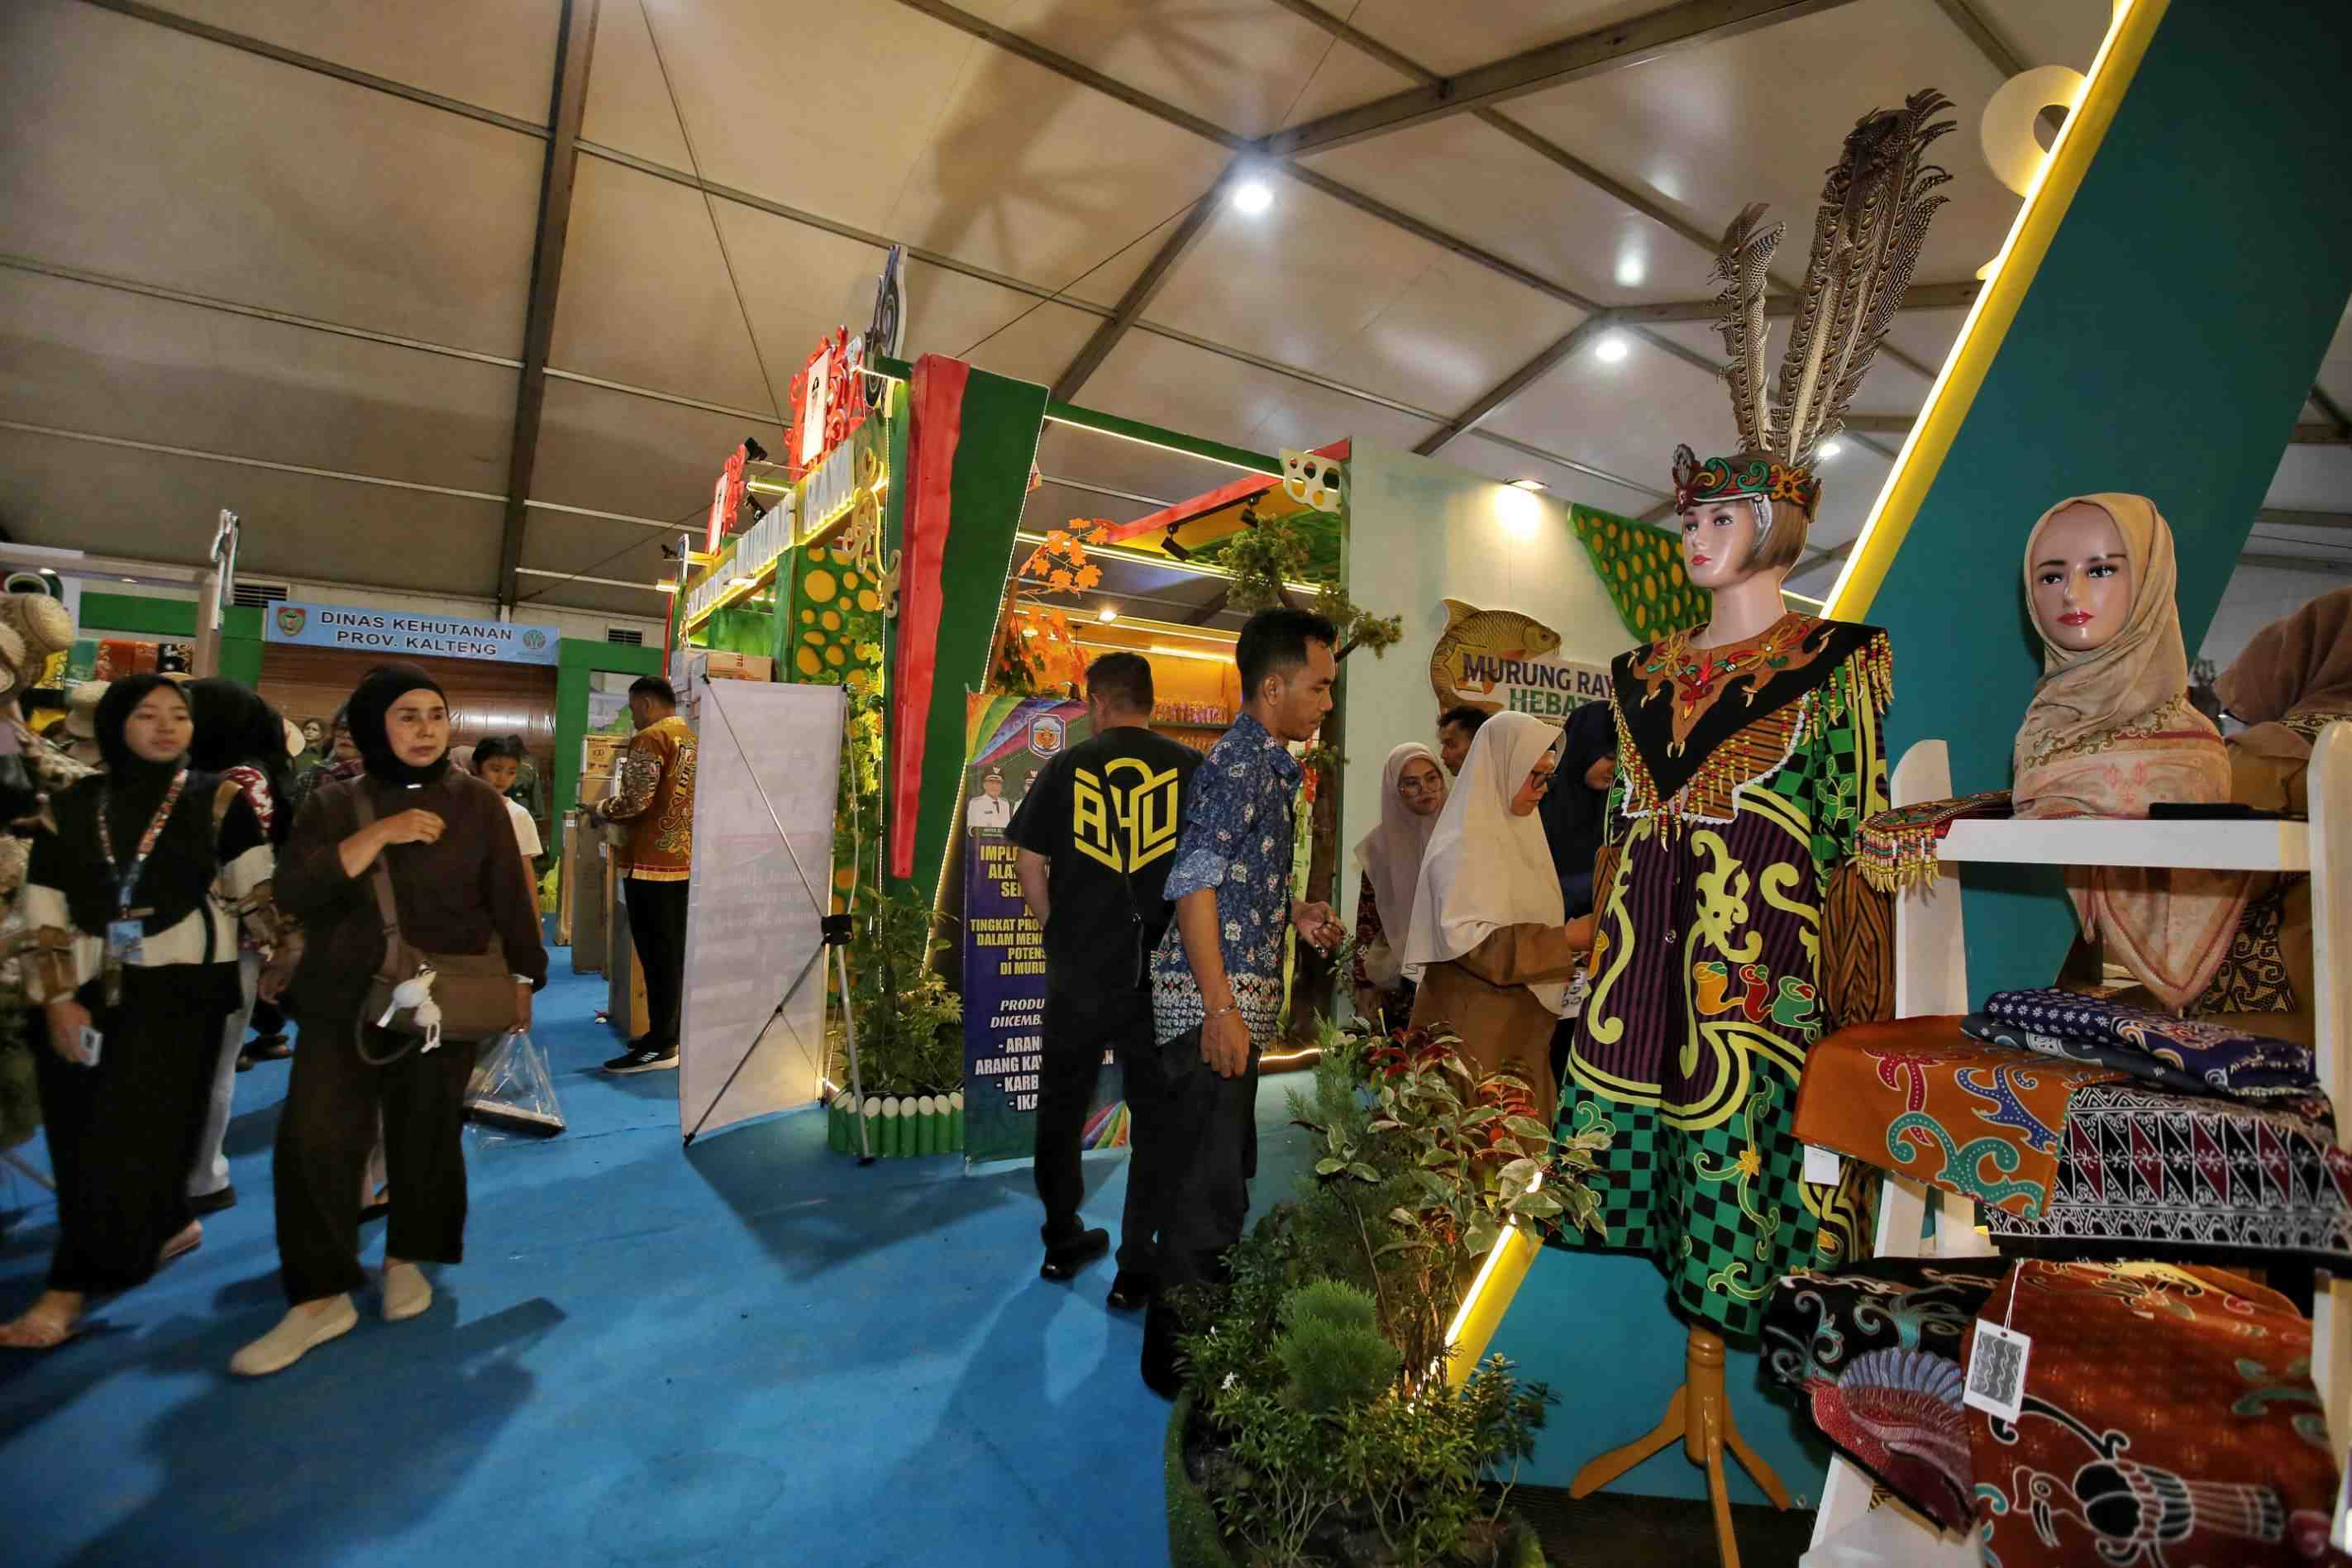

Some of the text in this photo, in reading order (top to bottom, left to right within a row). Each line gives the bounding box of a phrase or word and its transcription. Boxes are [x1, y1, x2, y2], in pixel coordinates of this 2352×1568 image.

[321, 612, 513, 641] DINAS KEHUTANAN
[336, 631, 497, 655] PROV. KALTENG
[1462, 653, 1572, 691] MURUNG
[988, 864, 1017, 879] ALA
[970, 918, 1043, 932] TINGKAT PRO
[976, 933, 1014, 946] DALAM
[1000, 961, 1046, 975] DI MURU
[1000, 998, 1045, 1012] PRODU
[990, 1014, 1043, 1028] DIKEMB
[1005, 1036, 1043, 1053] ARAN
[975, 1056, 1019, 1075] ARANG
[1004, 1075, 1039, 1092] KARB
